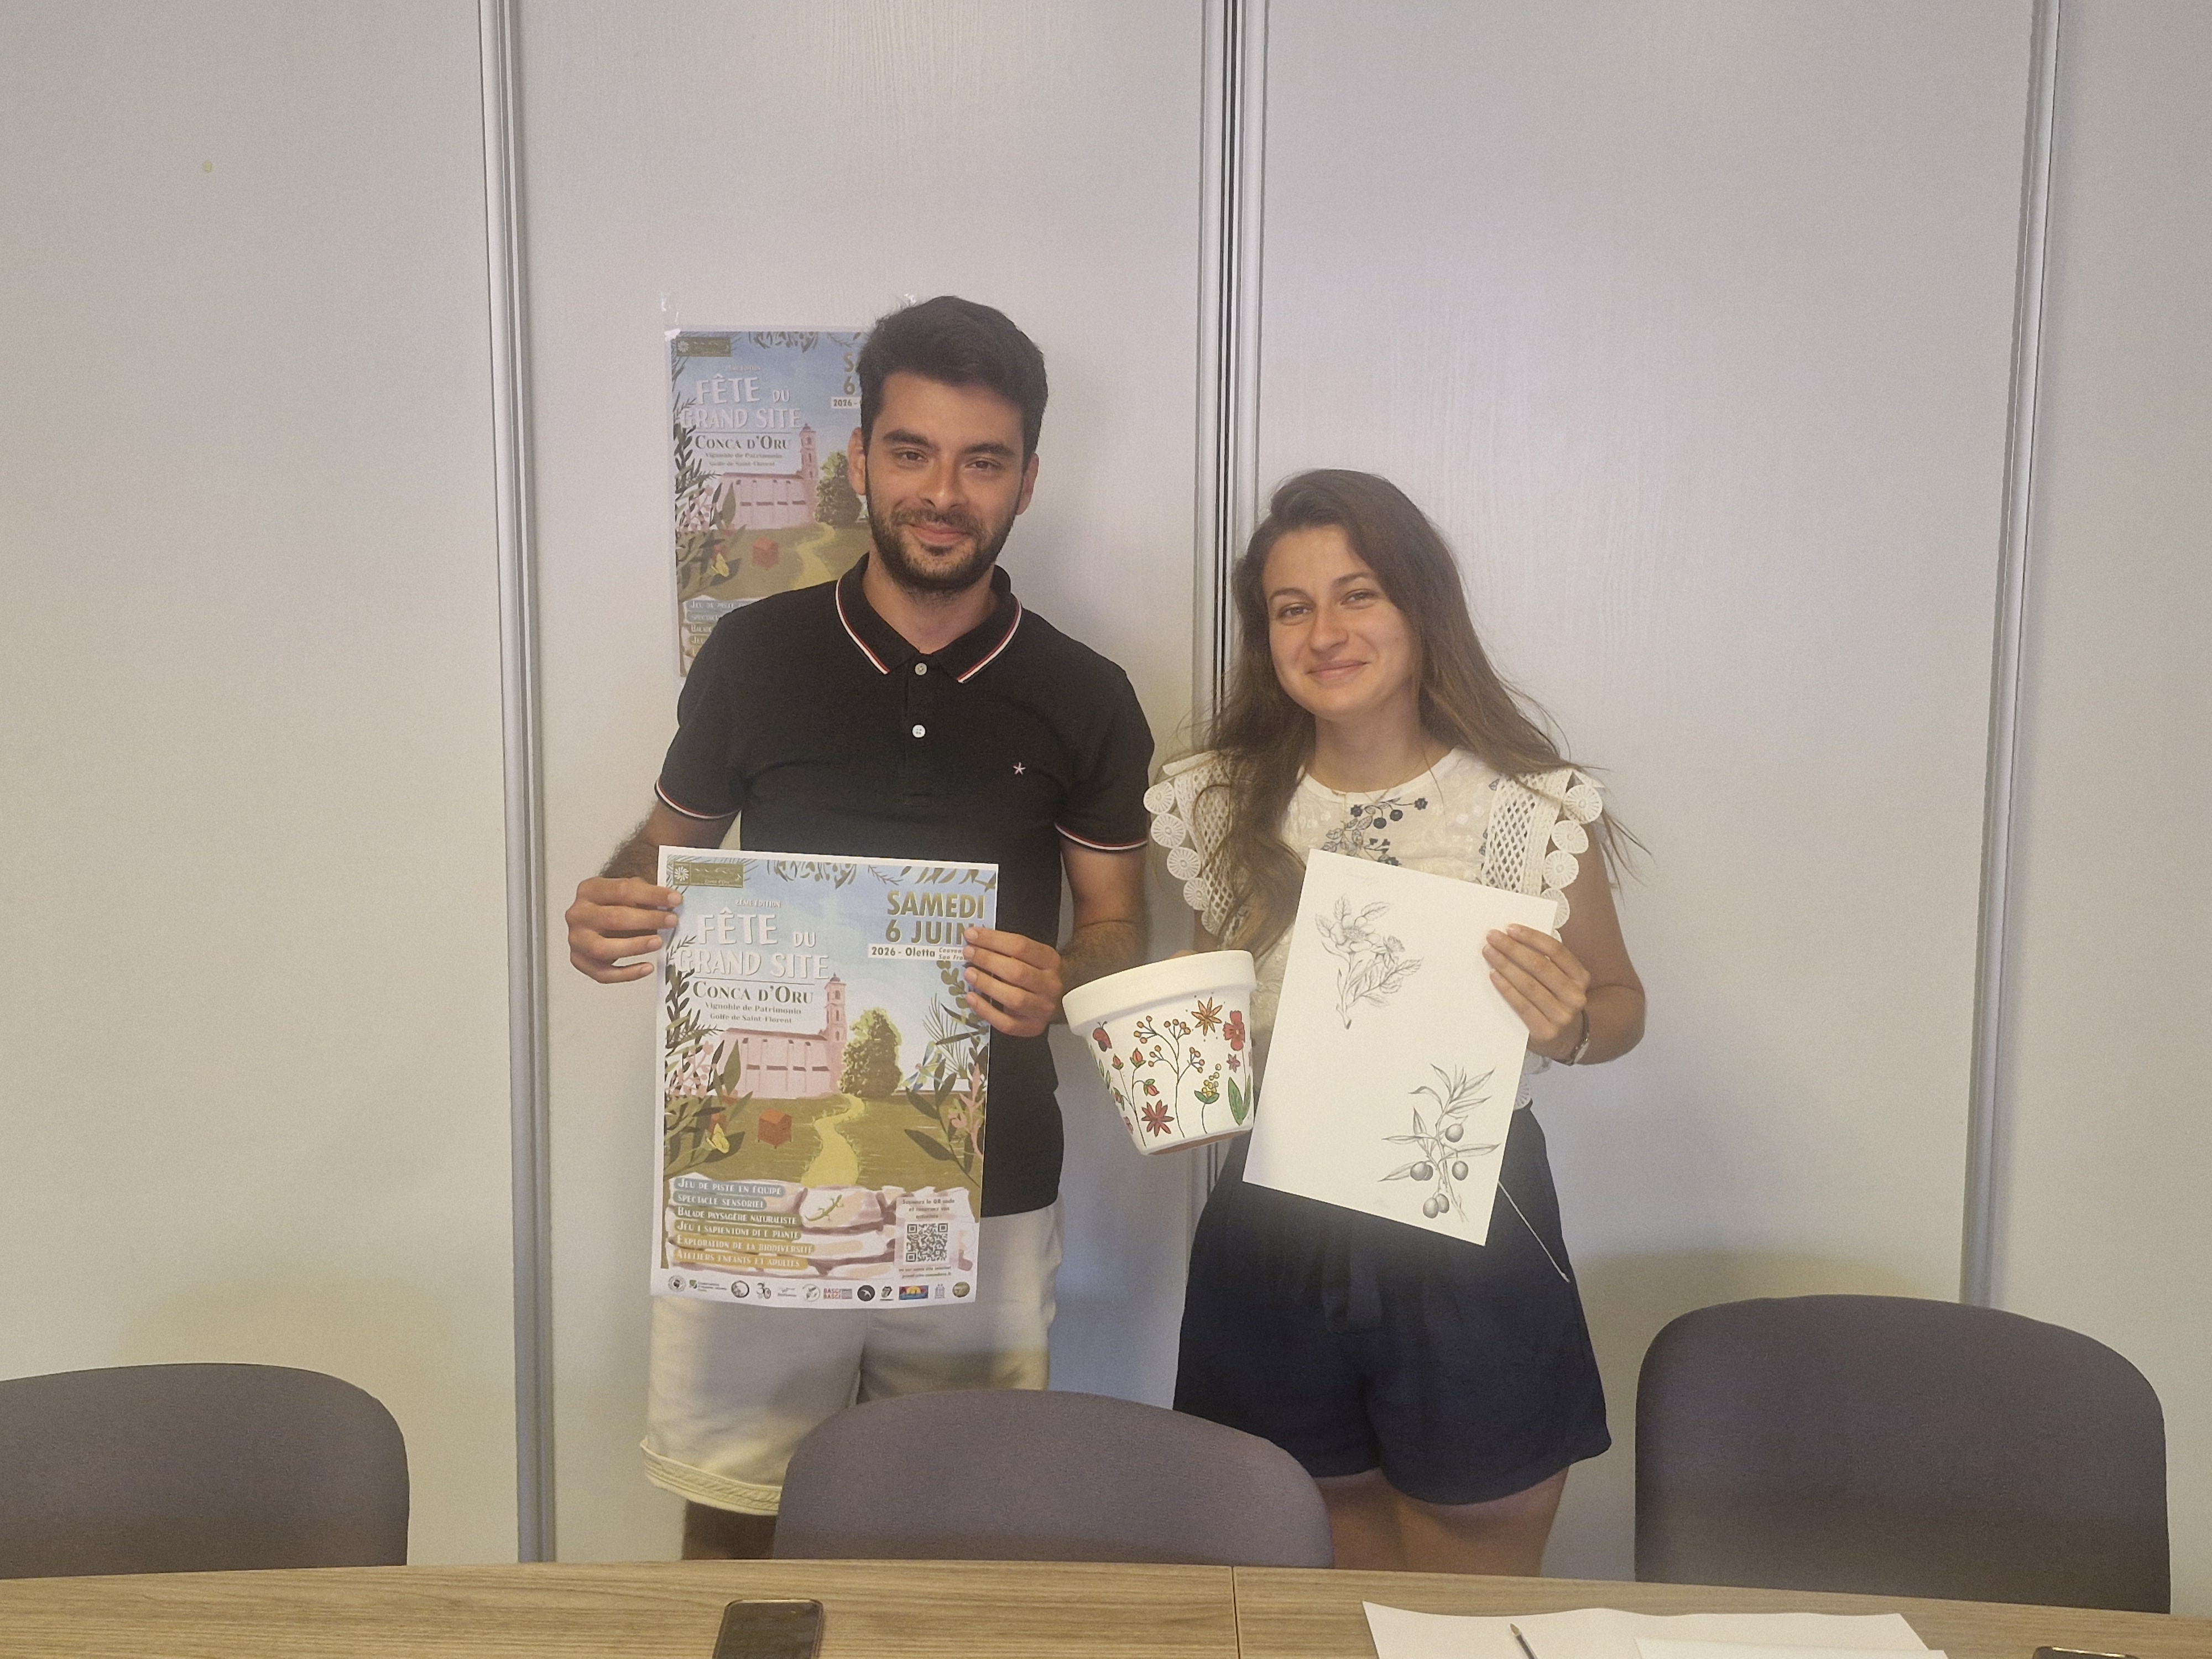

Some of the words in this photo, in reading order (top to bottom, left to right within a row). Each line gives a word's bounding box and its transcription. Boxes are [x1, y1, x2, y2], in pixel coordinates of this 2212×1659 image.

[696, 373, 760, 405] FÊTE
[772, 389, 790, 403] DU
[844, 376, 855, 395] 6
[680, 408, 749, 429] GRAND
[756, 408, 802, 429] SITE
[887, 890, 985, 920] SAMEDI
[697, 906, 779, 946] FÊTE
[792, 931, 817, 948] DU
[885, 919, 901, 943] 6
[871, 947, 896, 956] 2026
[905, 947, 935, 957] Oletta
[675, 949, 762, 976] GRAND
[770, 953, 830, 980] SITE
[705, 1001, 740, 1011] Vignoble
[754, 1005, 802, 1015] Patrimonio
[738, 1185, 749, 1193] EN
[733, 1241, 743, 1250] DE
